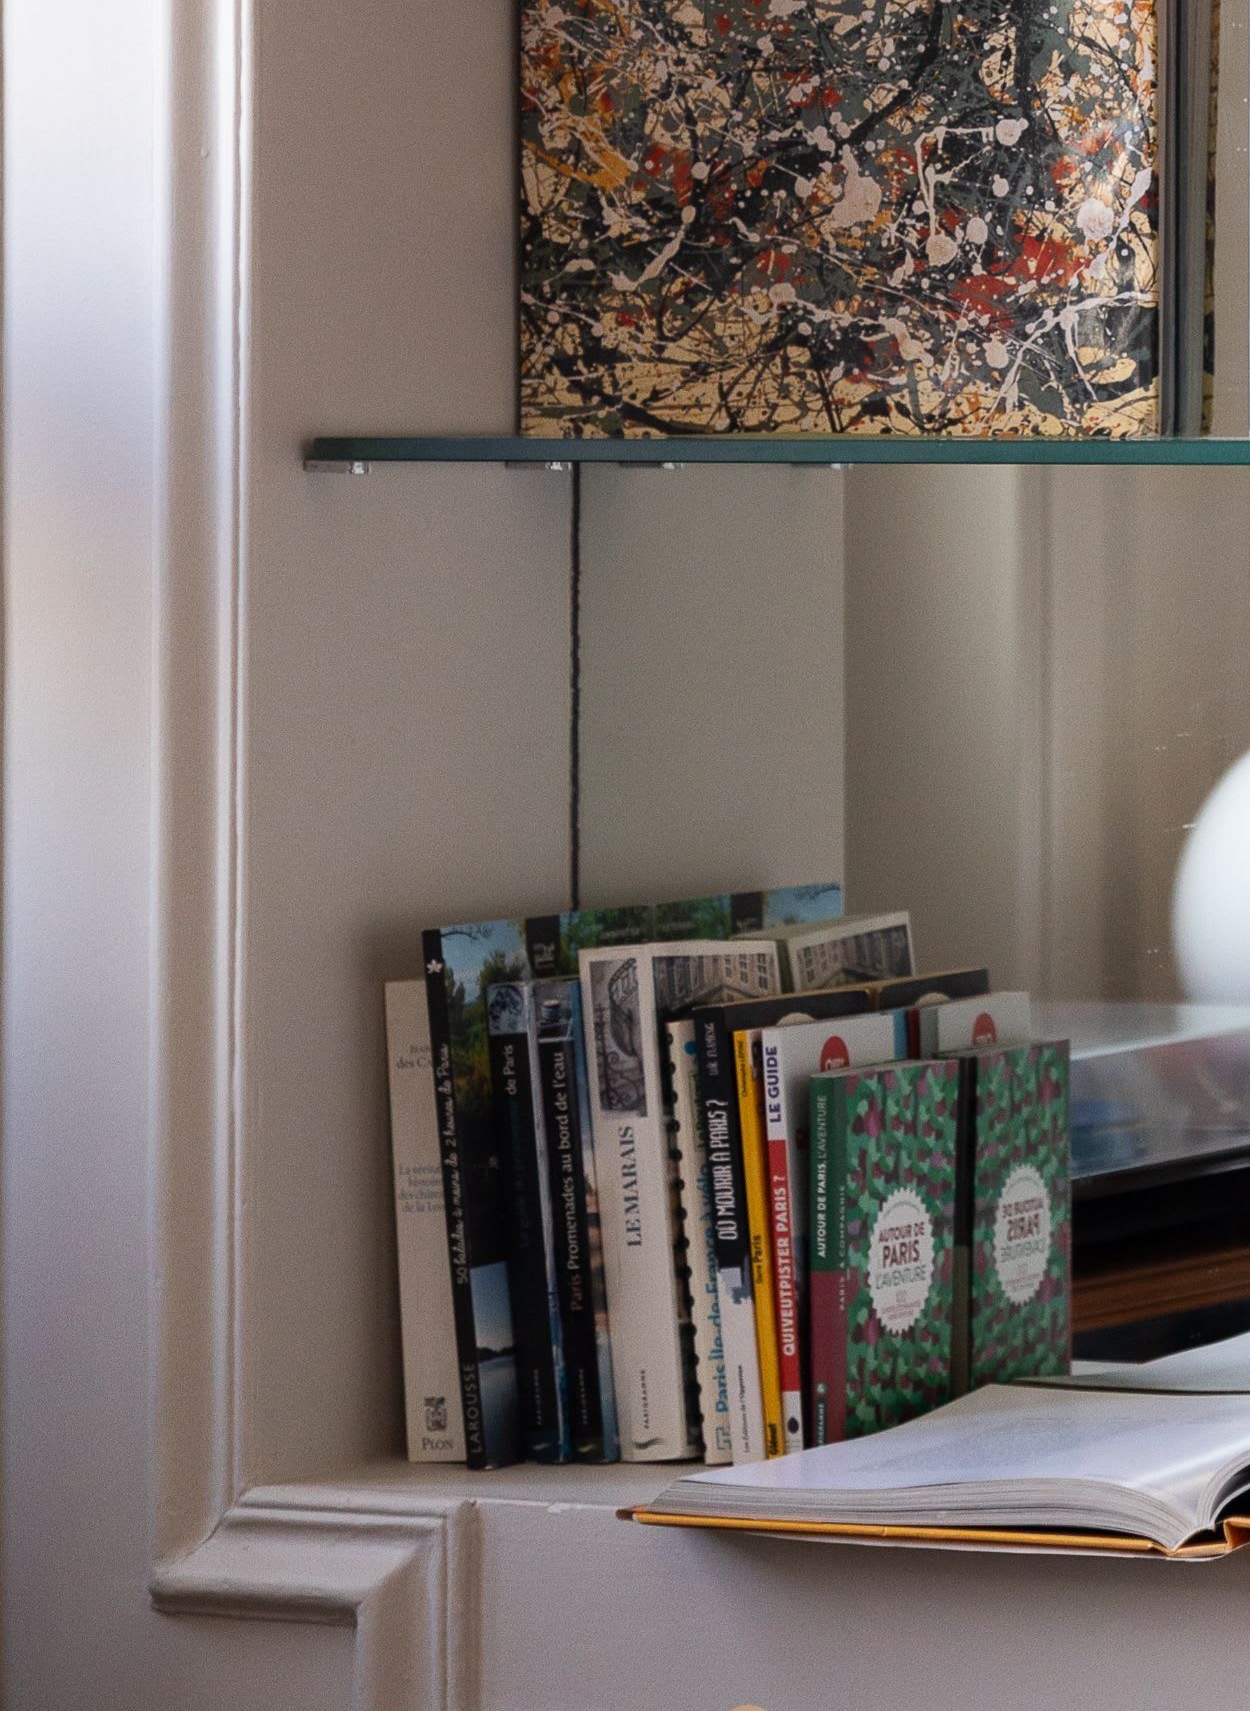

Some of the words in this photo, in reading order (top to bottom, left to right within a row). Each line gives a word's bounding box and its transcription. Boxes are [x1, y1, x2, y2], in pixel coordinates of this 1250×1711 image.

[436, 1043, 450, 1079] Paris
[503, 1044, 515, 1076] Paris
[549, 1052, 566, 1088] l'eau
[764, 1045, 780, 1099] GUIDE
[505, 1079, 517, 1096] de
[551, 1091, 567, 1111] de
[706, 1098, 729, 1108] ?
[441, 1097, 456, 1137] heures
[707, 1109, 730, 1149] PARIS
[767, 1103, 782, 1124] LE
[816, 1095, 827, 1160] L'AVENTURE
[444, 1138, 457, 1148] 2
[552, 1114, 572, 1149] bord
[560, 1152, 575, 1173] au
[617, 1125, 639, 1216] MARAIS
[708, 1150, 731, 1163] À
[450, 1170, 463, 1206] moins
[713, 1164, 737, 1217] MOURIR
[773, 1174, 785, 1183] ?
[775, 1186, 789, 1232] PARIS
[816, 1196, 827, 1211] DE
[559, 1177, 580, 1271] Promenades
[624, 1216, 643, 1248] LE
[717, 1220, 739, 1241] OÙ
[816, 1213, 827, 1258] AUTOUR
[879, 1225, 912, 1243] AUTOUR
[914, 1221, 925, 1236] DE
[451, 1218, 468, 1266] balades
[751, 1234, 763, 1263] Paris
[882, 1240, 920, 1269] PARIS
[456, 1266, 469, 1285] 50
[568, 1273, 584, 1311] Paris
[778, 1236, 796, 1357] QUIVEUTPISTER
[462, 1360, 482, 1455] LAROUSSE
